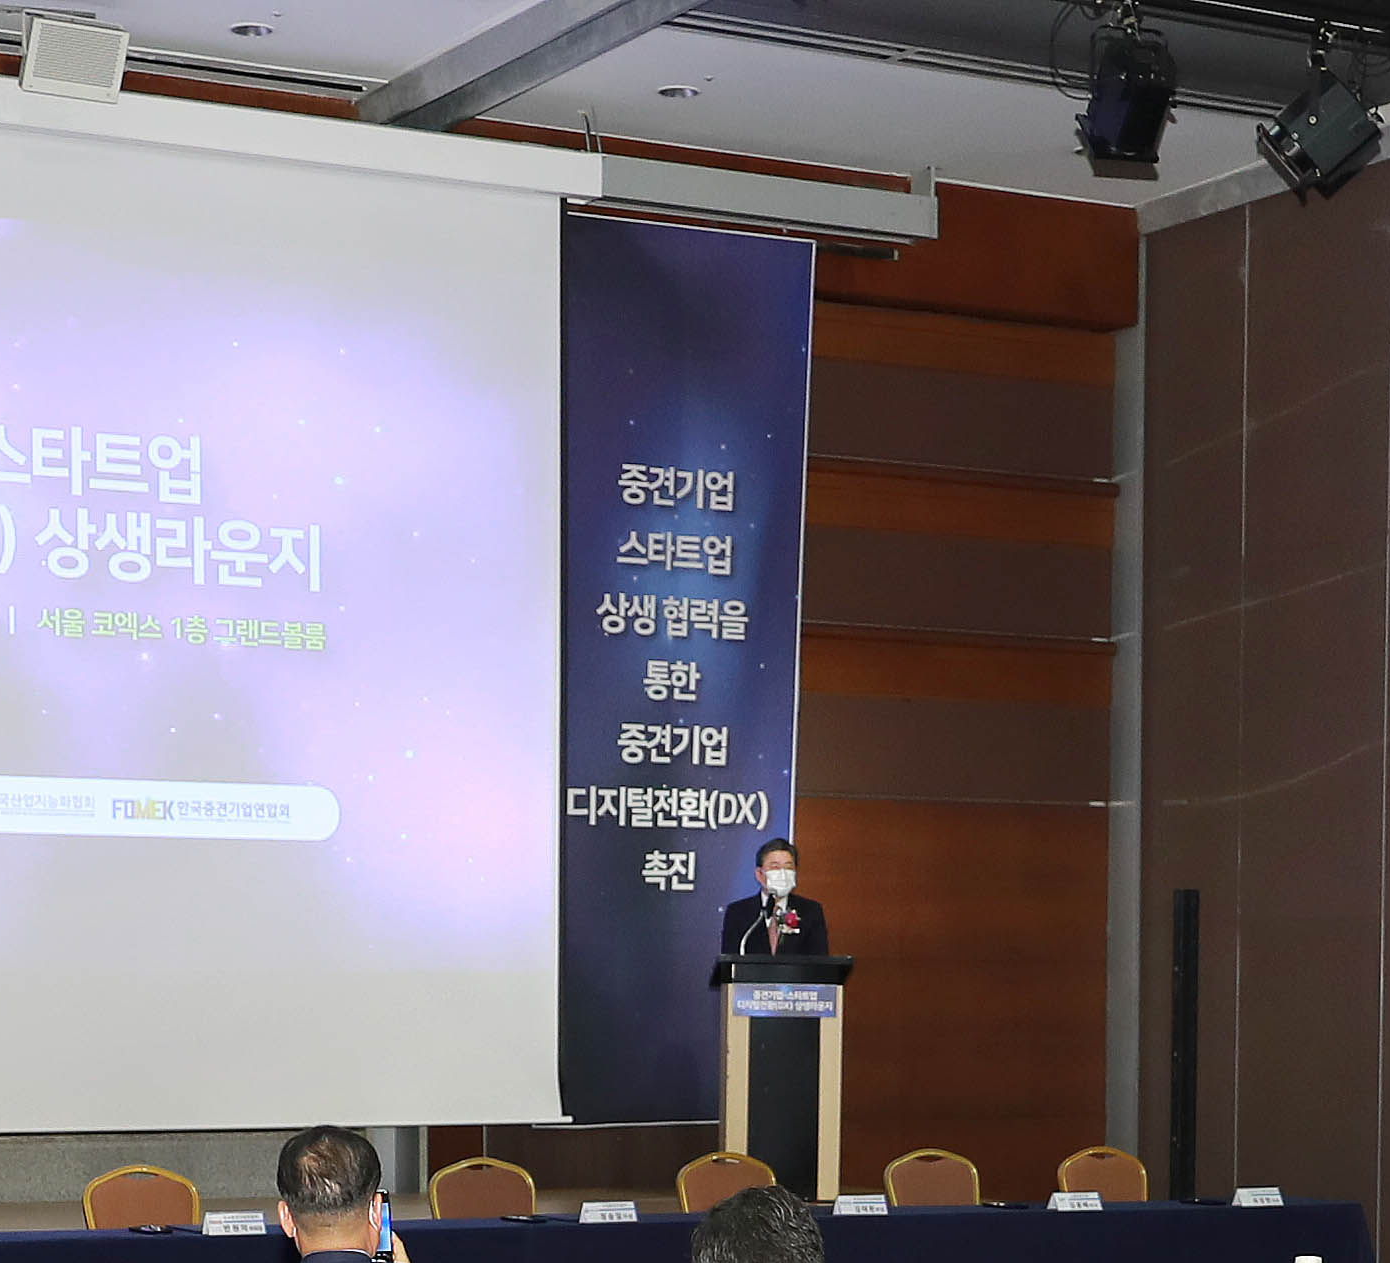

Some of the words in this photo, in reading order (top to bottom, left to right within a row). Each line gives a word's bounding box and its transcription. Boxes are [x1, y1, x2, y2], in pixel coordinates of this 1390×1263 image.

[617, 463, 735, 511] 중견기업
[35, 507, 323, 593] 상생라운지
[616, 531, 733, 576] 스타트업
[37, 607, 85, 638] 서울
[91, 611, 162, 640] 코엑스
[170, 615, 208, 645] 1층
[213, 619, 326, 650] 그랜드볼룸
[596, 593, 657, 635] 상생
[662, 596, 749, 641] 협력을
[643, 660, 701, 702] 통한
[617, 724, 728, 766] 중견기업
[566, 787, 768, 831] 디지털전환(DX)
[641, 851, 696, 892] 촉진
